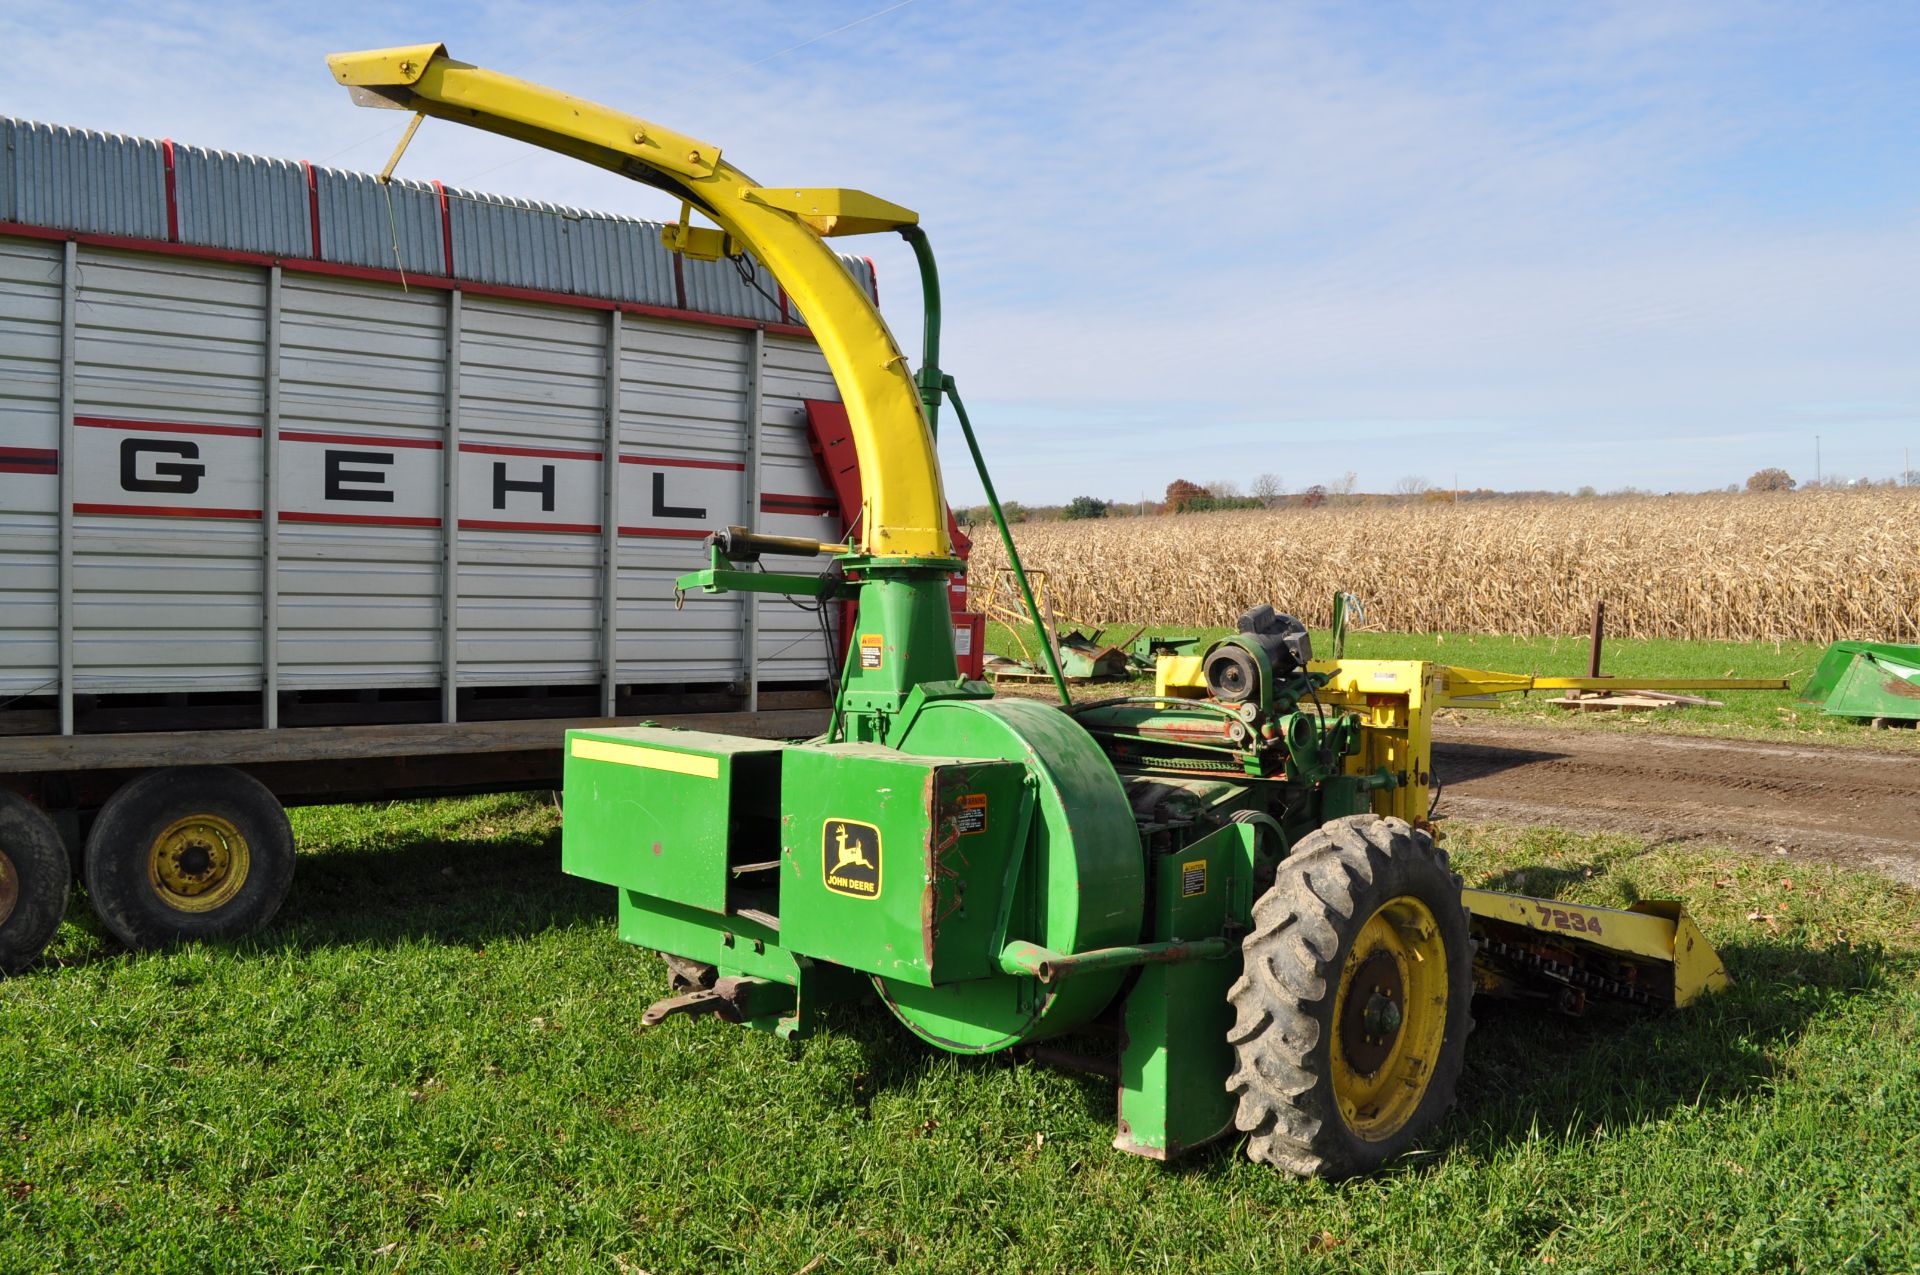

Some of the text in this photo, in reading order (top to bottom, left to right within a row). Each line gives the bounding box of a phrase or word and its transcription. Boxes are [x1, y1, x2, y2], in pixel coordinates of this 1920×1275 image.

[120, 438, 707, 518] GEHL
[827, 875, 875, 893] JOHN DEERE
[1535, 905, 1603, 937] 7234
